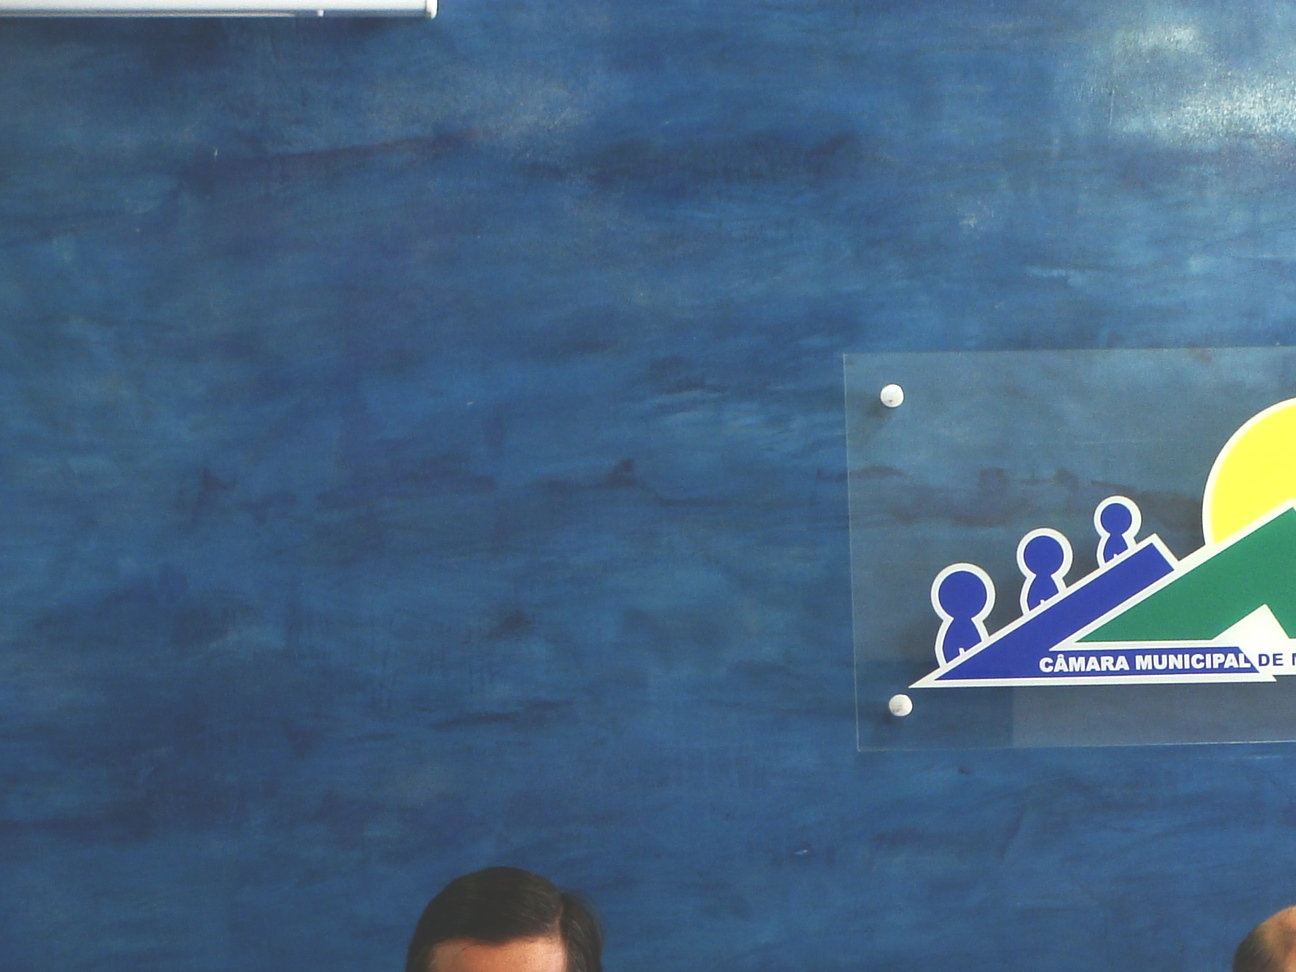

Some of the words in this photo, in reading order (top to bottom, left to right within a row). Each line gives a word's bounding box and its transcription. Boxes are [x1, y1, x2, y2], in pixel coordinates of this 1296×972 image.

[1039, 653, 1129, 673] CÂMARA
[1135, 652, 1251, 670] MUNICIPAL
[1258, 653, 1284, 667] DE
